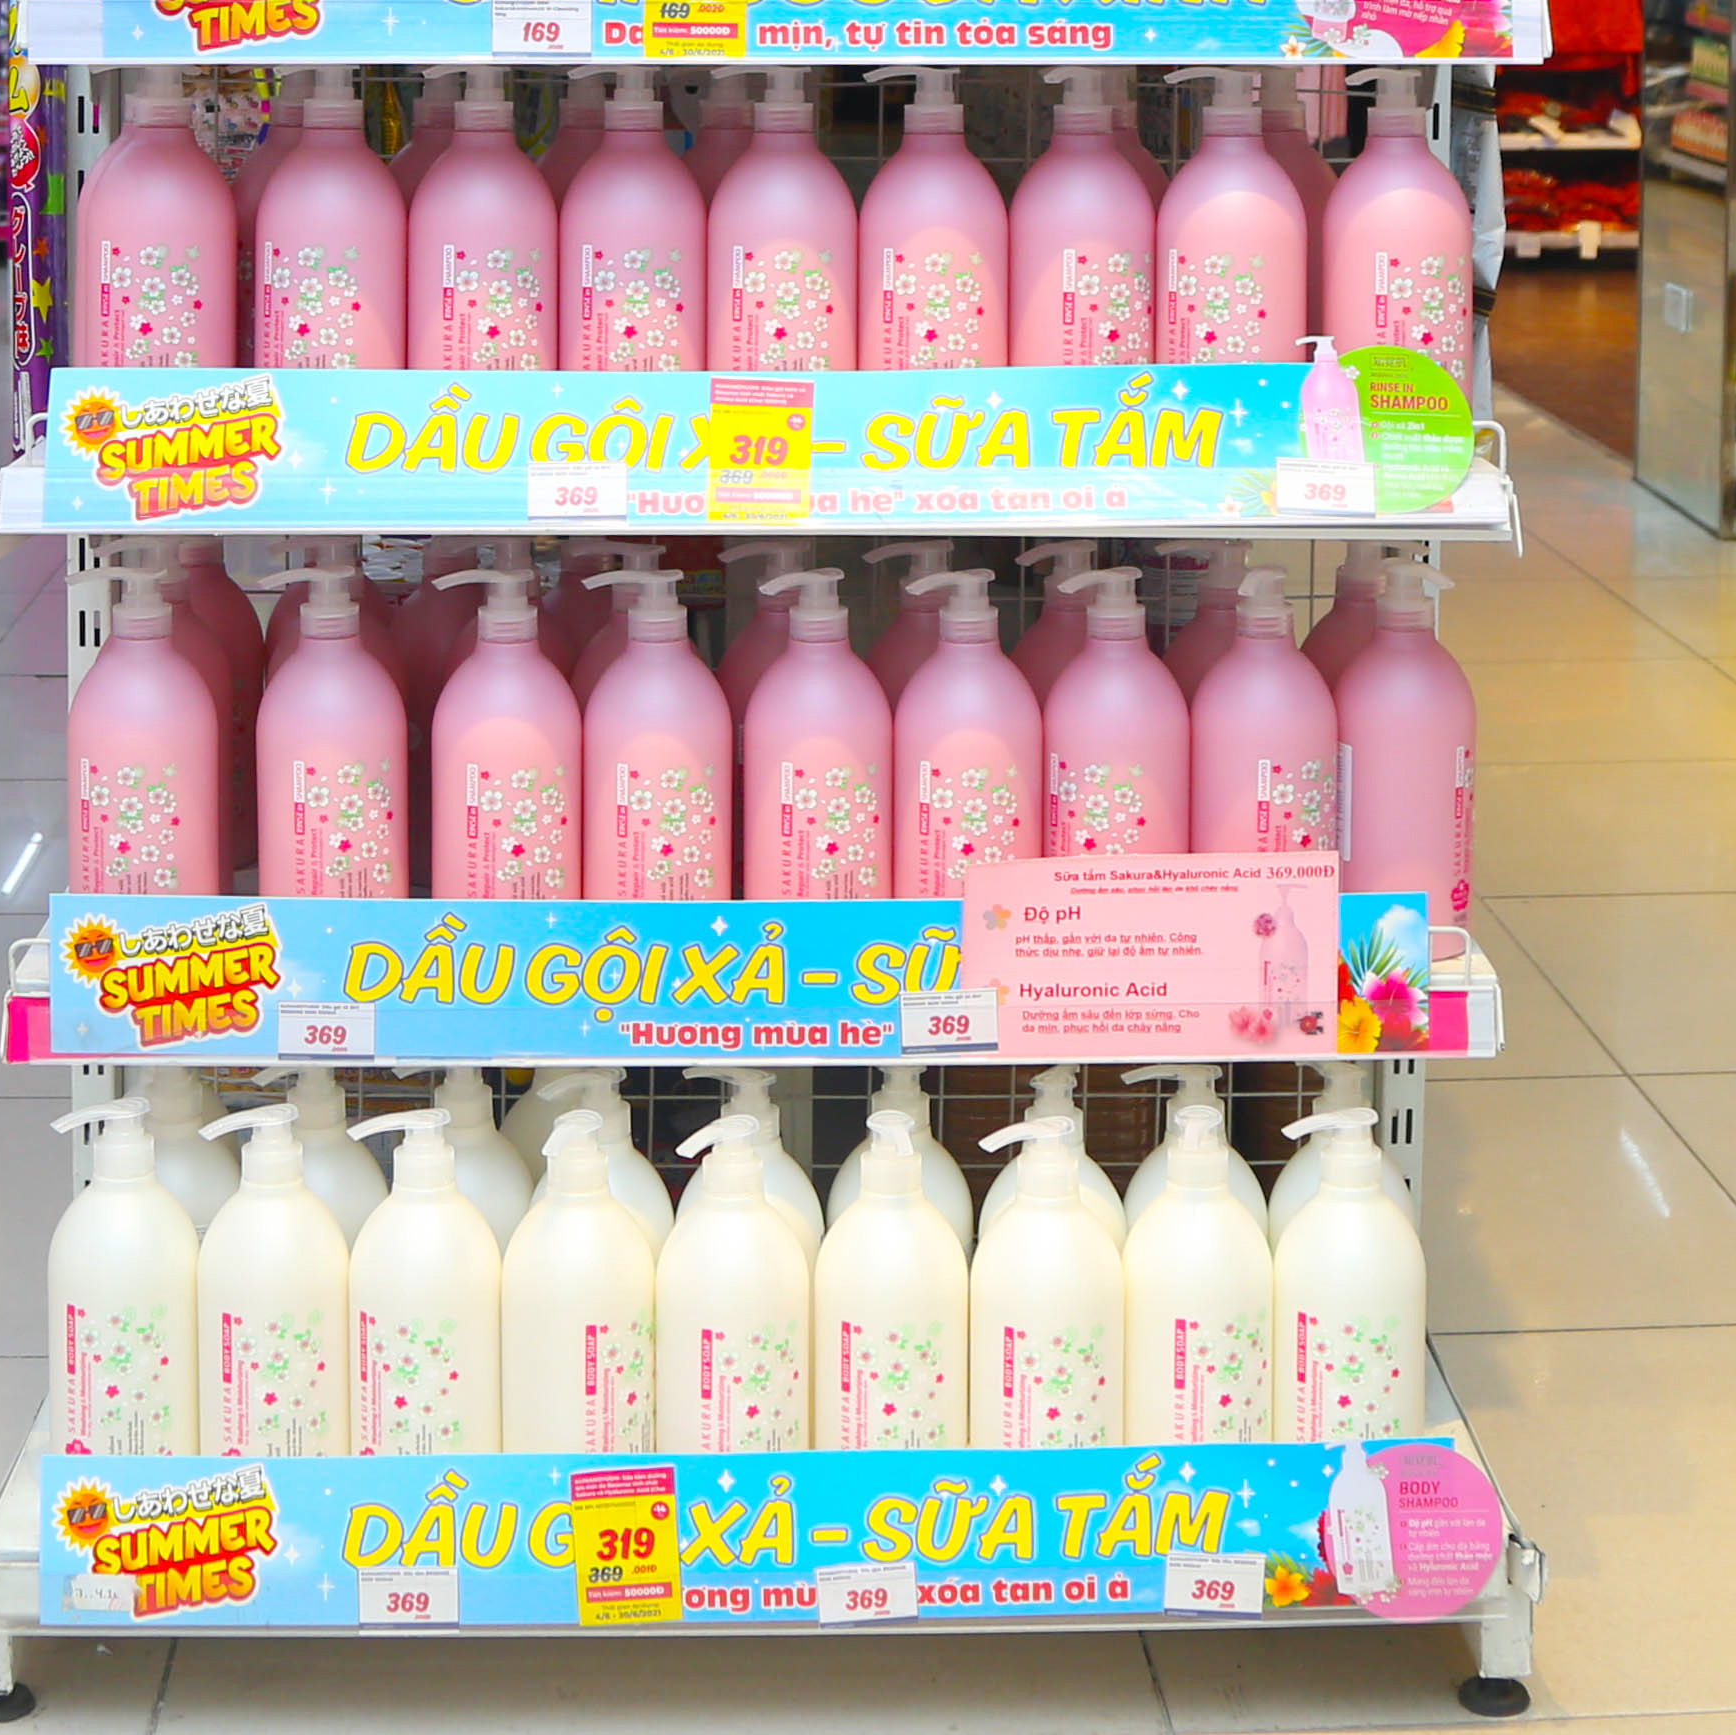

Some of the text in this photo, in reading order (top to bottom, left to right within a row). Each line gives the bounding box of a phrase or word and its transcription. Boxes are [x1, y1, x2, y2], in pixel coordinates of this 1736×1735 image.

[523, 22, 560, 42] 169
[759, 18, 1113, 49] mịn, tự tin tỏa sáng
[1370, 382, 1414, 393] RINSE IN
[1370, 395, 1449, 411] SHAMPOO
[345, 372, 1223, 475] DẦU SỮA TẮM
[729, 434, 789, 466] 319
[1304, 483, 1346, 501] 369
[1054, 865, 1335, 882] Sữa tắm Sakura&Hyaluronic Acid 369.000Đ
[1024, 904, 1081, 924] Độ pH
[120, 904, 269, 960] しあわせな夏
[98, 941, 281, 1012] SUMMER
[343, 911, 784, 1022] DẦU GỘI XẢ
[1019, 982, 1167, 1001] Hyaluronic Acid
[133, 989, 259, 1049] TIMES
[927, 1015, 971, 1038] 369
[303, 1022, 348, 1047] 369
[753, 1018, 833, 1047] mùa
[1399, 1481, 1441, 1495] BODY
[342, 1453, 1231, 1569] DẦU XẢ SỮA TẮM
[1399, 1497, 1458, 1509] SHAMPOO
[596, 1527, 656, 1562] 319
[386, 1592, 430, 1613] 369
[993, 1582, 1053, 1605] tan
[1064, 1575, 1097, 1603] oi
[1190, 1577, 1237, 1603] 369
